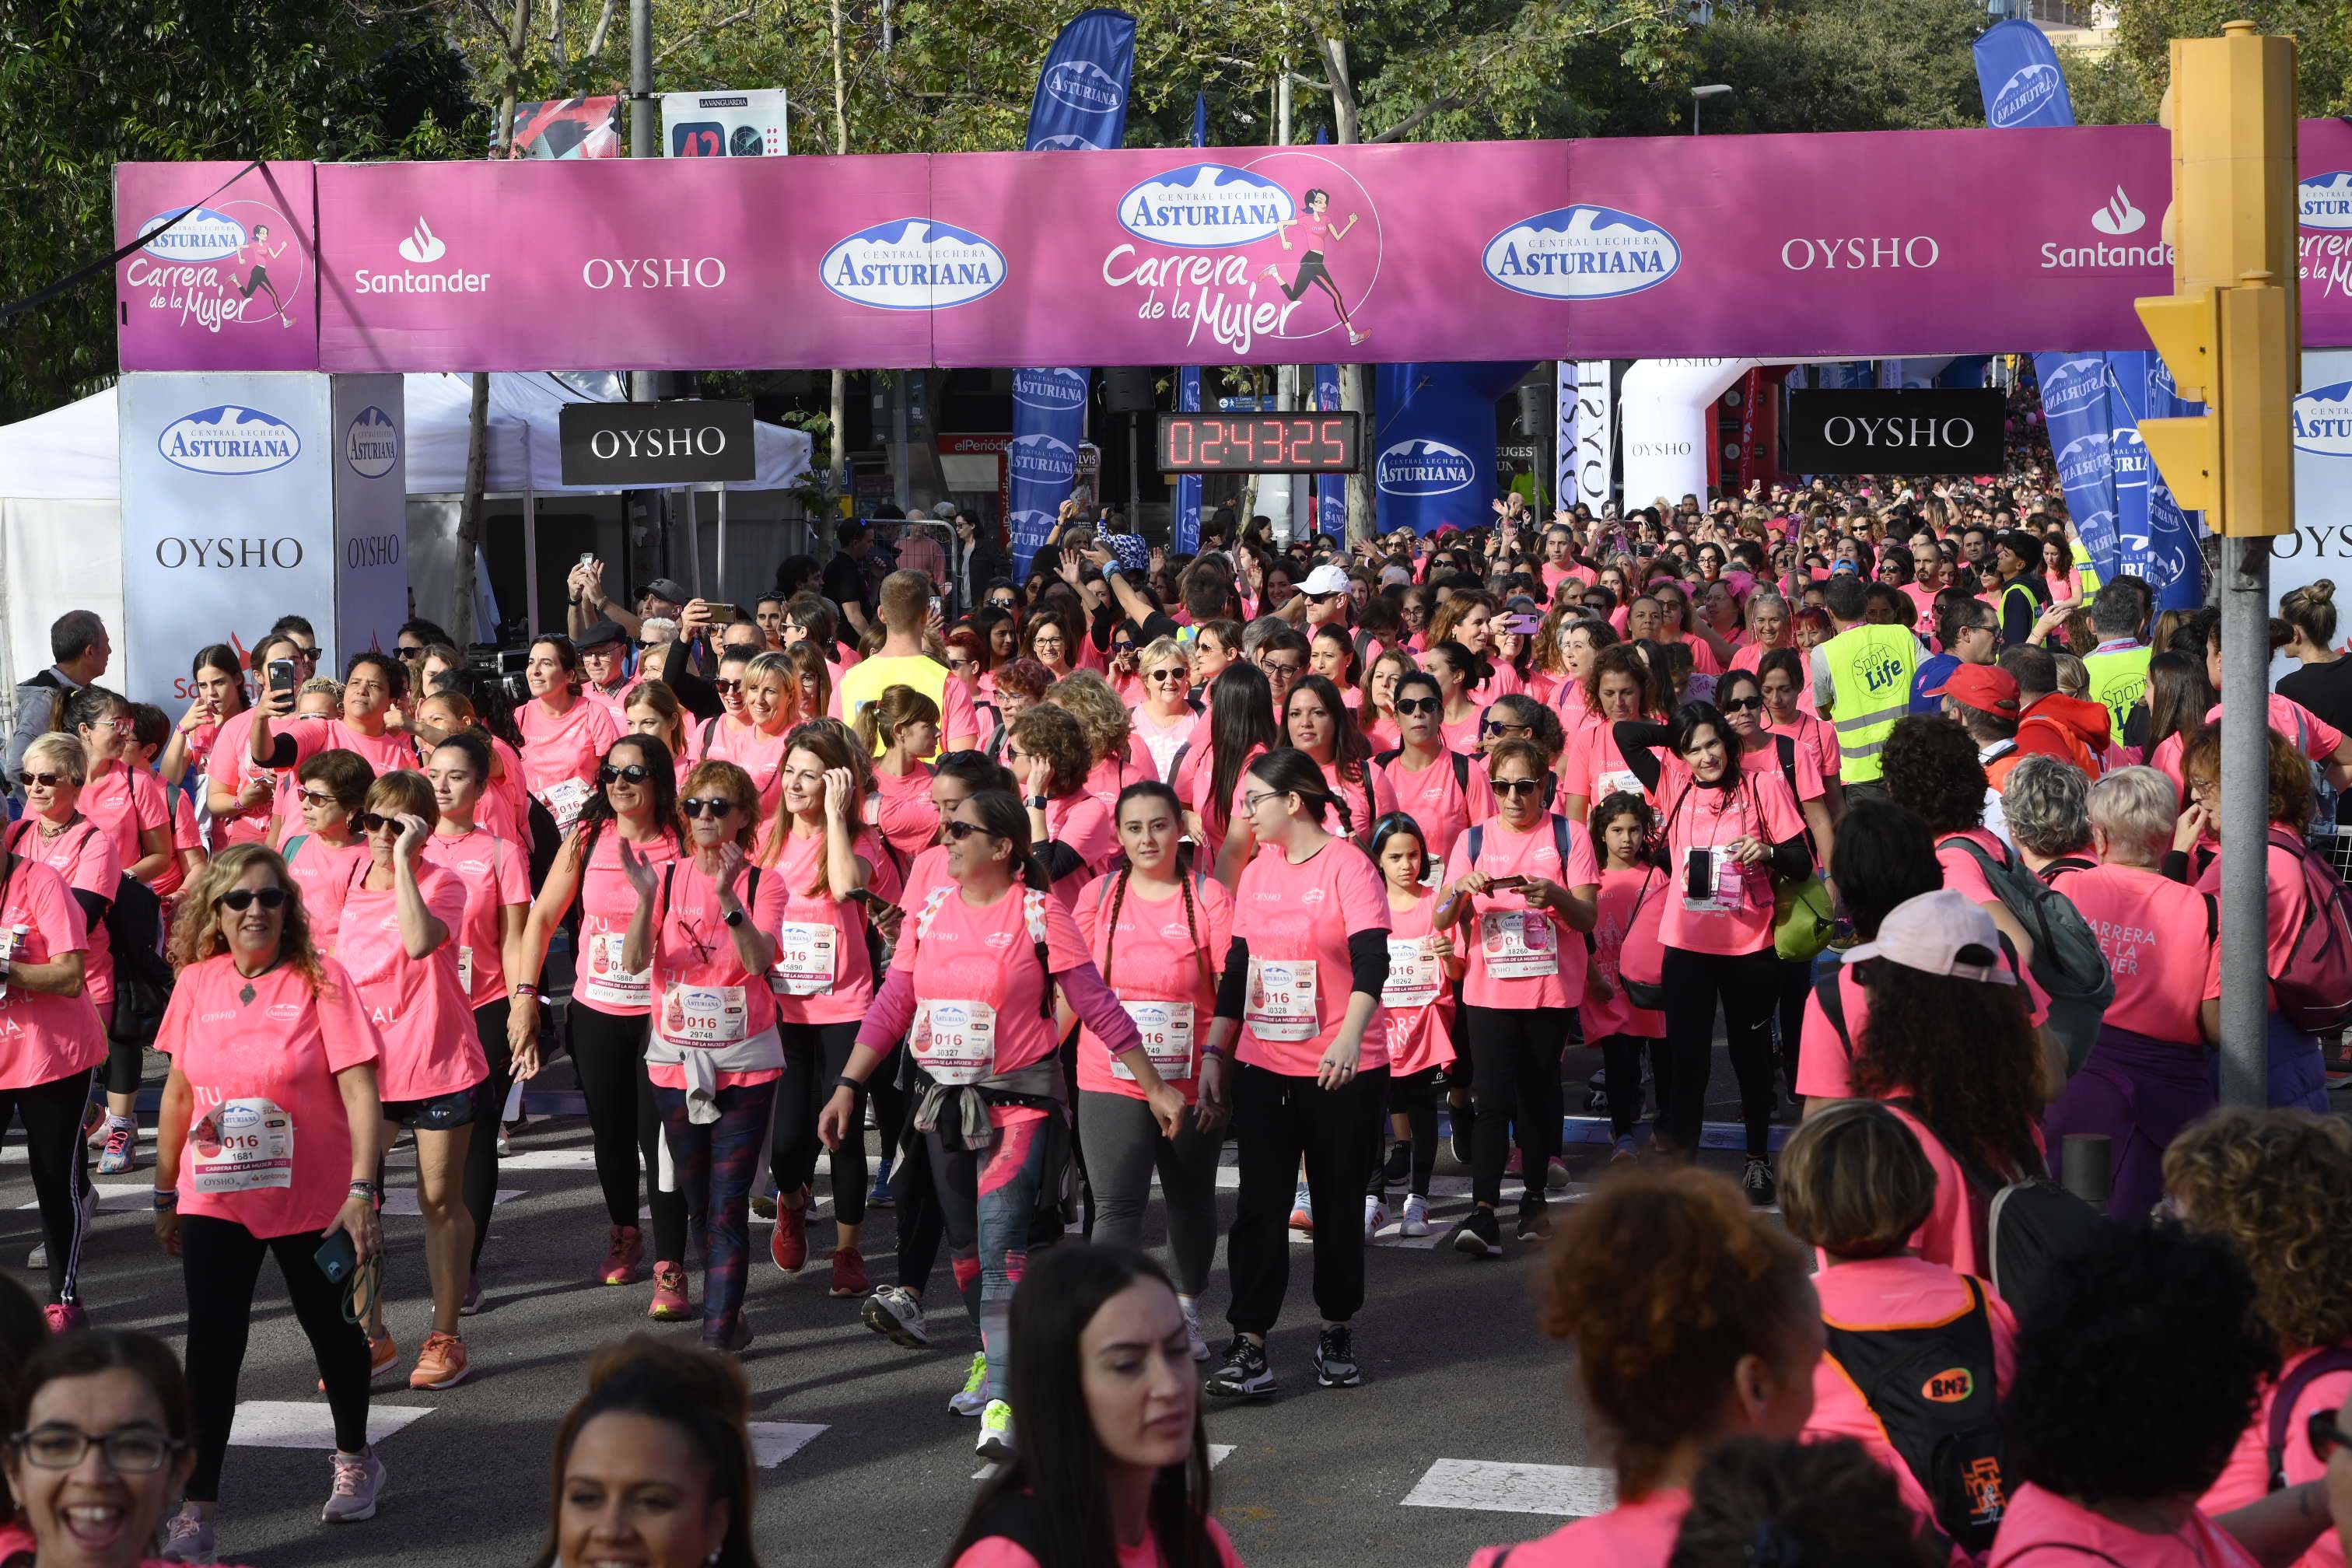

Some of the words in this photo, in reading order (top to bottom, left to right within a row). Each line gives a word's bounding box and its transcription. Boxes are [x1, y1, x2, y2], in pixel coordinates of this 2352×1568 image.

[1050, 72, 1117, 106] ASTURIANA
[1159, 192, 1213, 201] CENTRAL
[1131, 195, 1281, 226] ASTURIANA
[863, 250, 922, 258] CENTRAL
[928, 250, 986, 258] LECHERA
[1529, 239, 1591, 247] CENTRAL
[1596, 237, 1658, 246] LECHERA
[1781, 236, 1939, 270] OYSHO
[2041, 242, 2178, 268] Santande
[835, 252, 993, 286] ASTURIANA
[1103, 243, 1248, 287] Carrera
[1497, 242, 1665, 276] ASTURIANA
[2313, 257, 2327, 279] la
[127, 258, 219, 287] Carrera
[355, 268, 491, 293] Santander
[583, 257, 726, 289] OYSHO
[150, 289, 166, 308] de
[170, 289, 183, 309] la
[180, 285, 253, 332] Mujer
[1139, 289, 1165, 319] de
[1172, 288, 1191, 319] la
[1187, 282, 1303, 355] Mujer
[1013, 373, 1082, 401] ASTURIANA
[170, 431, 290, 457] ASTURIANA
[592, 426, 726, 460] OYSHO
[955, 439, 1013, 451] elPeriódi
[1171, 422, 1344, 464] 02:43:25
[1824, 417, 1975, 449] OYSHO
[350, 434, 394, 460] ASTURIANA
[1633, 442, 1692, 457] OYSHO
[1011, 455, 1073, 474] STURIANA
[1381, 462, 1468, 484] ASTURIANA
[156, 537, 303, 569] OYSHO
[348, 534, 399, 569] OYSHO
[1853, 645, 1889, 676] Sport
[1865, 660, 1902, 691] Life
[560, 801, 579, 813] 016
[2083, 916, 2156, 946] ARRERA
[2116, 942, 2137, 958] LA
[1389, 966, 1414, 975] 016
[1265, 992, 1290, 1003] 016
[688, 1017, 716, 1028] 016
[670, 1038, 691, 1046] CARRERA
[935, 1034, 962, 1046] 016
[195, 1086, 222, 1105] TU
[224, 1135, 258, 1149] 016
[233, 1152, 254, 1160] 1681
[204, 1178, 235, 1186] OYSHO
